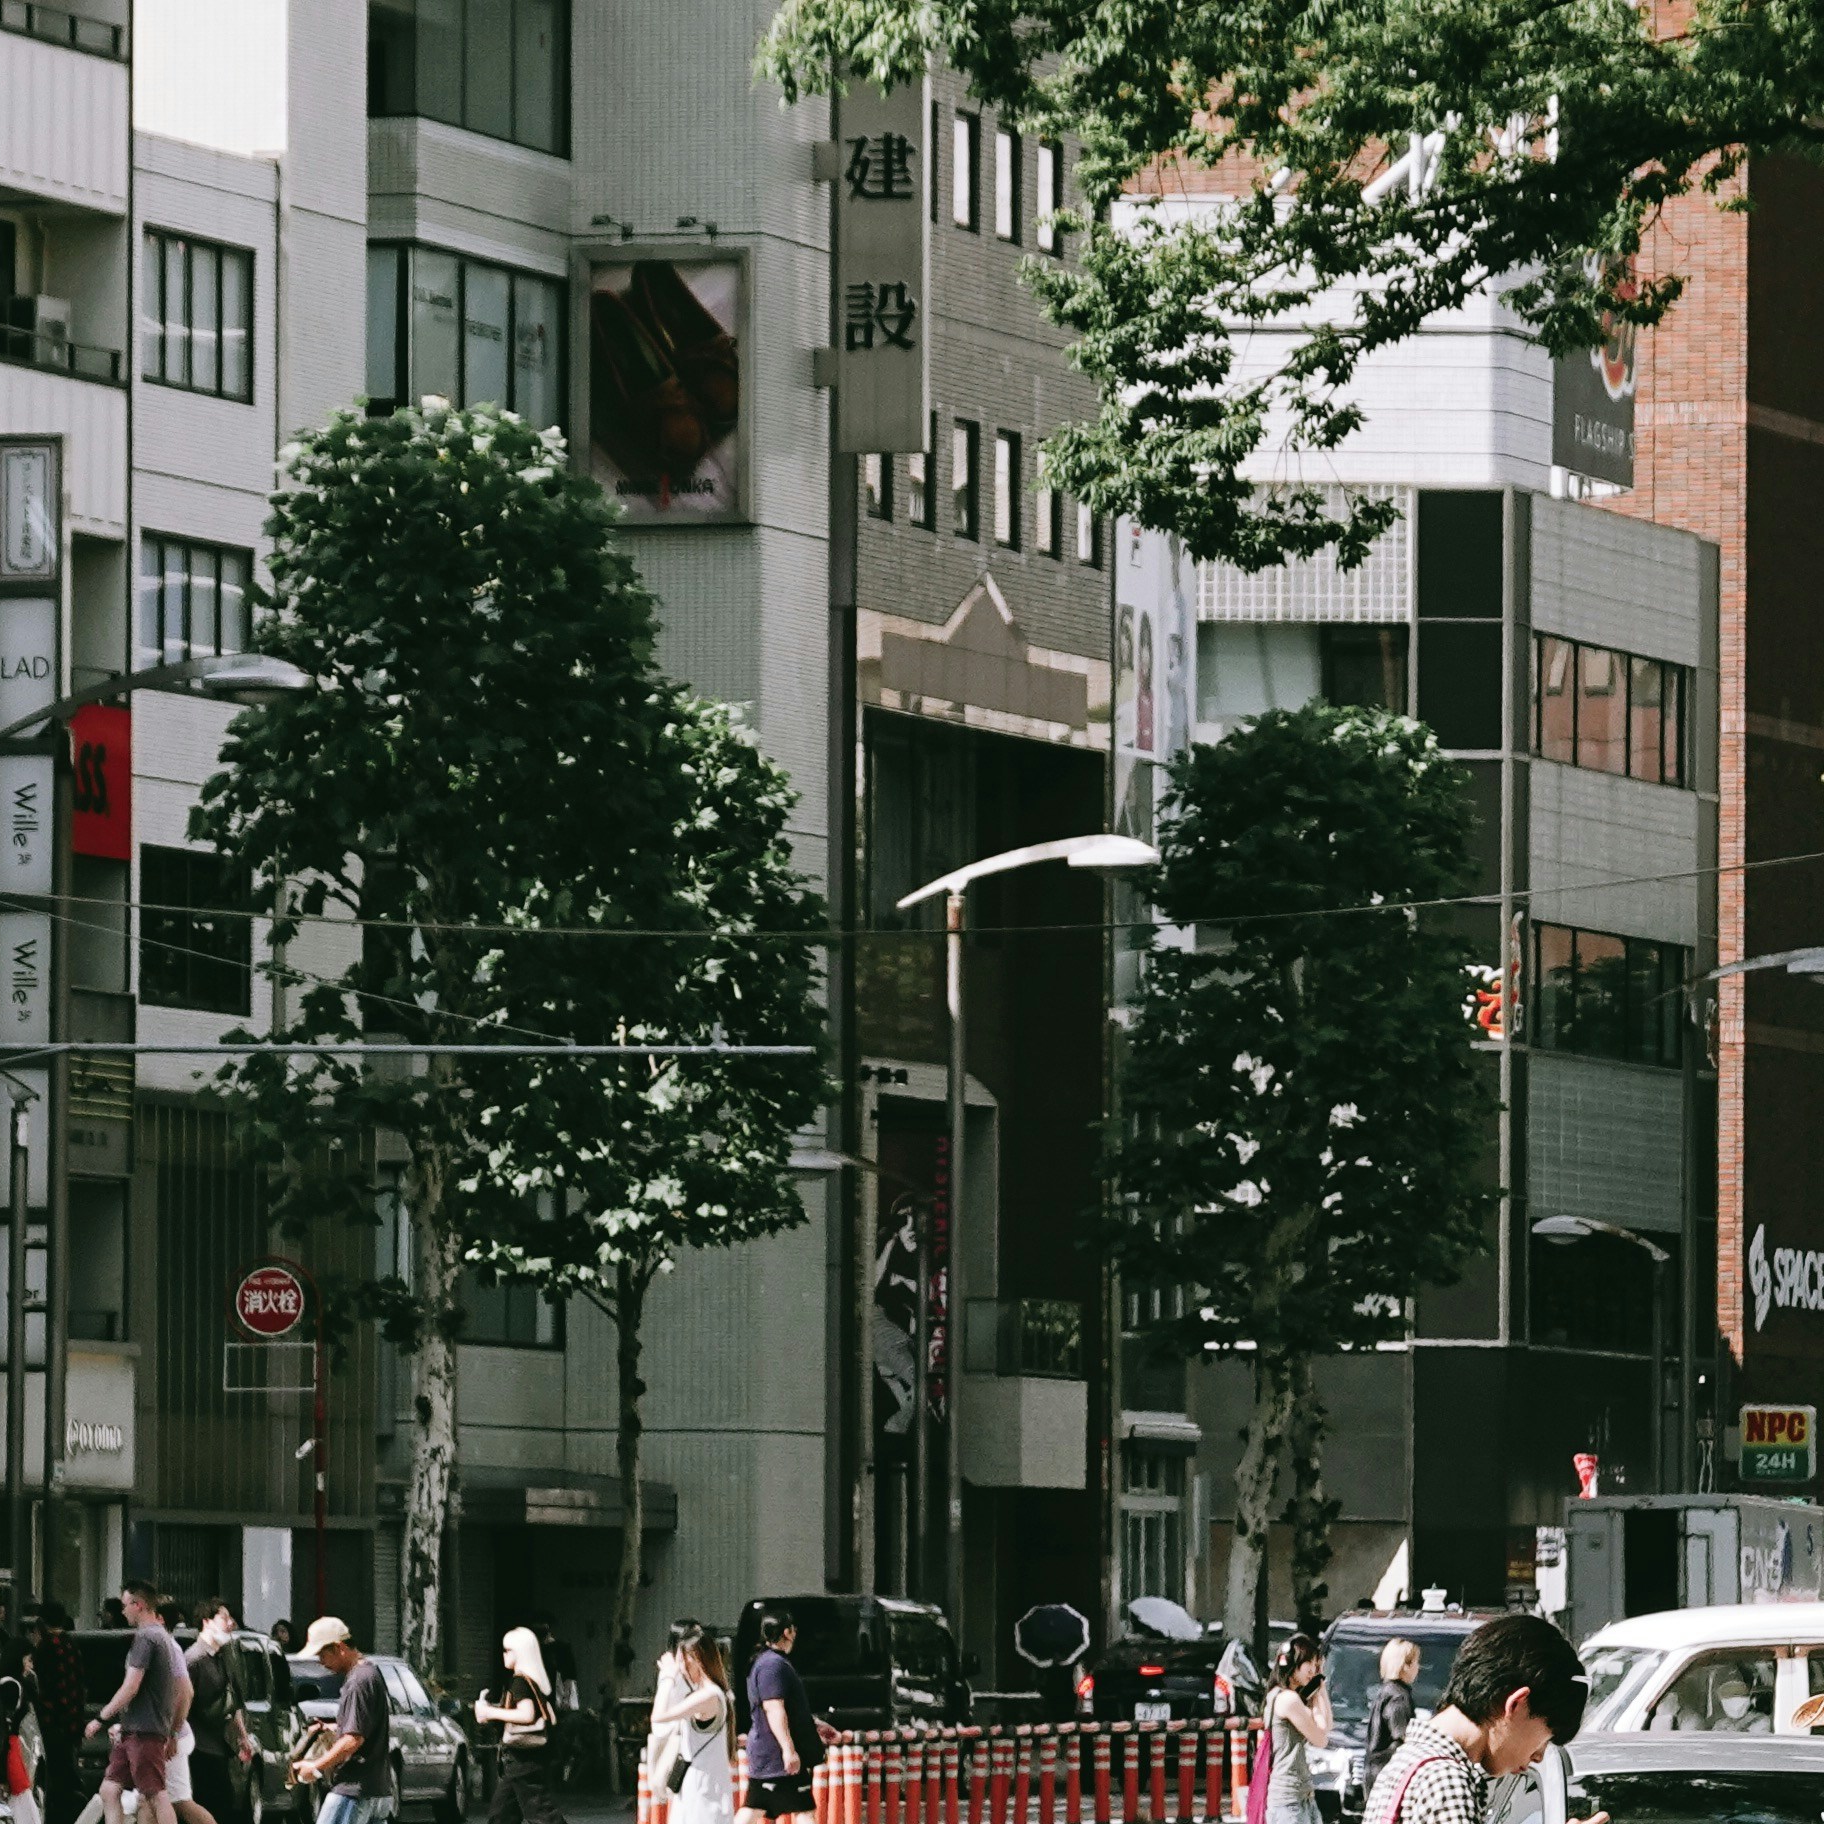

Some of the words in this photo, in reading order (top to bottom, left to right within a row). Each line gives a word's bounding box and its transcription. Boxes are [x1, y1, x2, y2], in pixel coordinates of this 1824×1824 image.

[844, 131, 918, 352] 建設
[0, 656, 51, 680] LAD
[12, 782, 39, 848] Wille
[12, 939, 39, 1005] Wille
[243, 1288, 298, 1315] 消火栓
[1745, 1411, 1807, 1444] NPC
[1755, 1452, 1796, 1470] 24H
